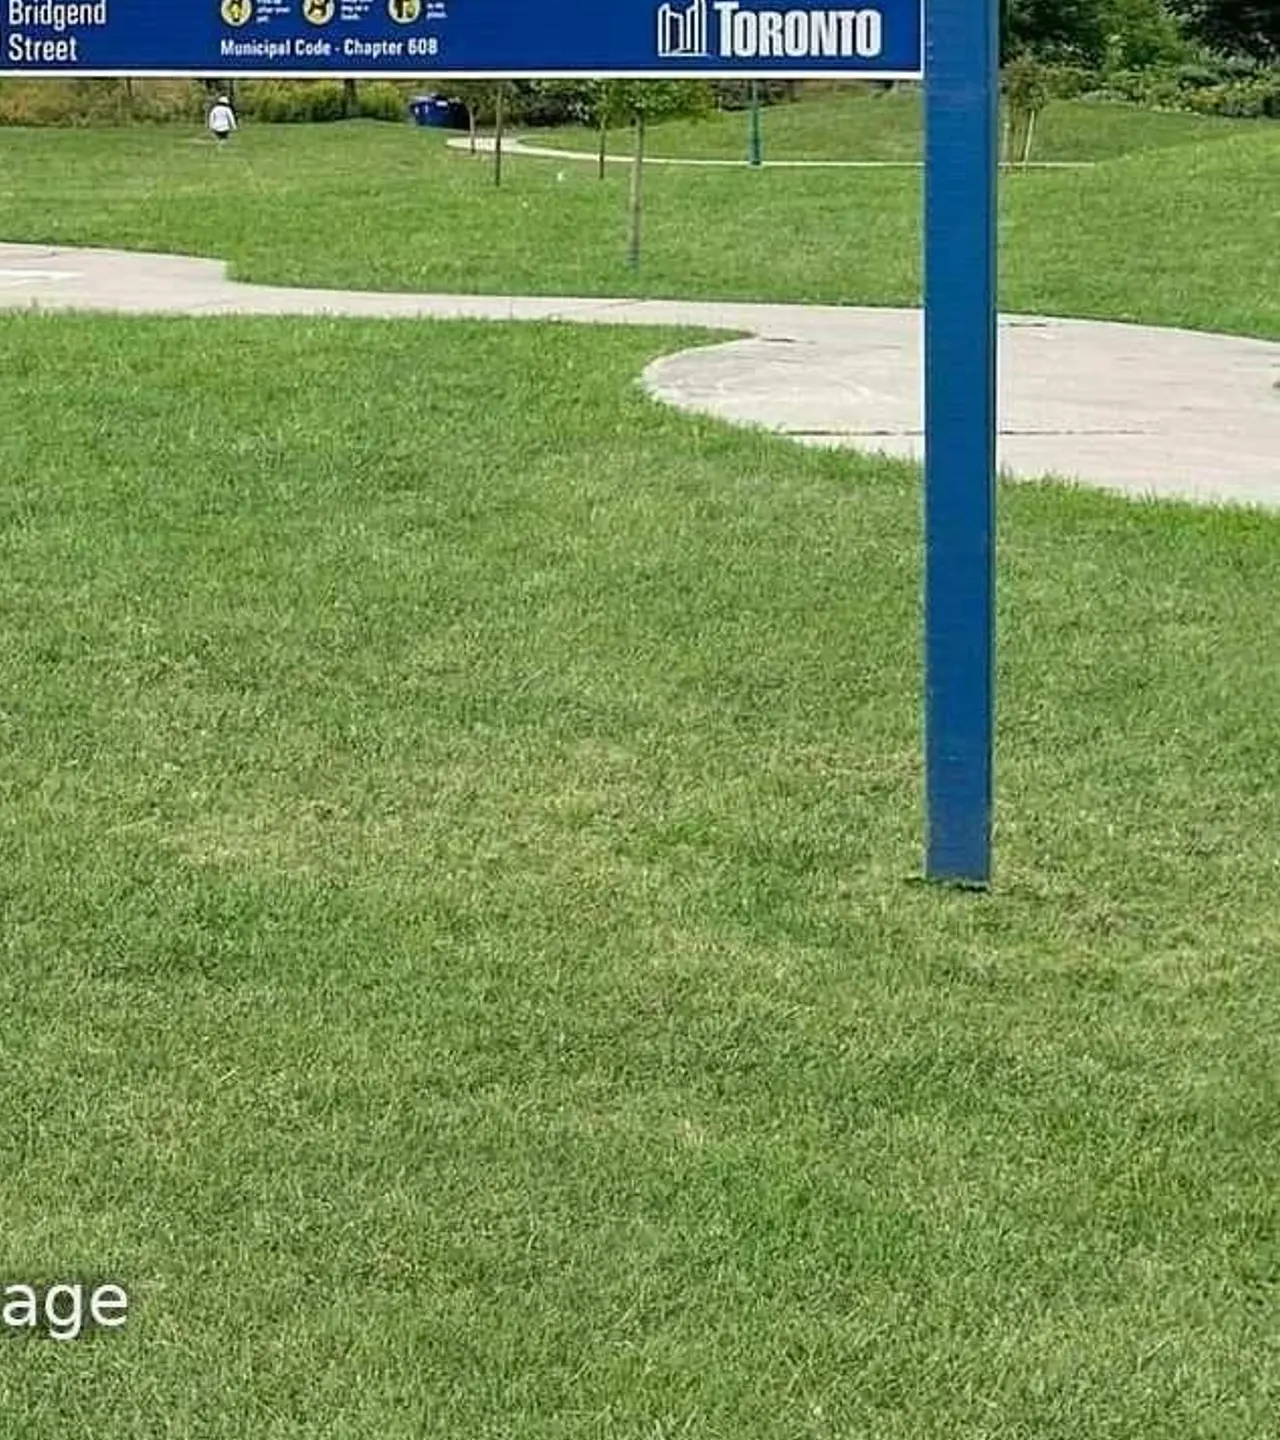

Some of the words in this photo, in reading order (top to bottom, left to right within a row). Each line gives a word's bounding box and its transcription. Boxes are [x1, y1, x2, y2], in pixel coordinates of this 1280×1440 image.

[713, 0, 883, 58] TORONTO
[7, 32, 79, 62] Street
[219, 38, 291, 59] Municipal
[295, 38, 332, 57] Code
[343, 37, 403, 59] Chapter
[407, 37, 439, 56] 608
